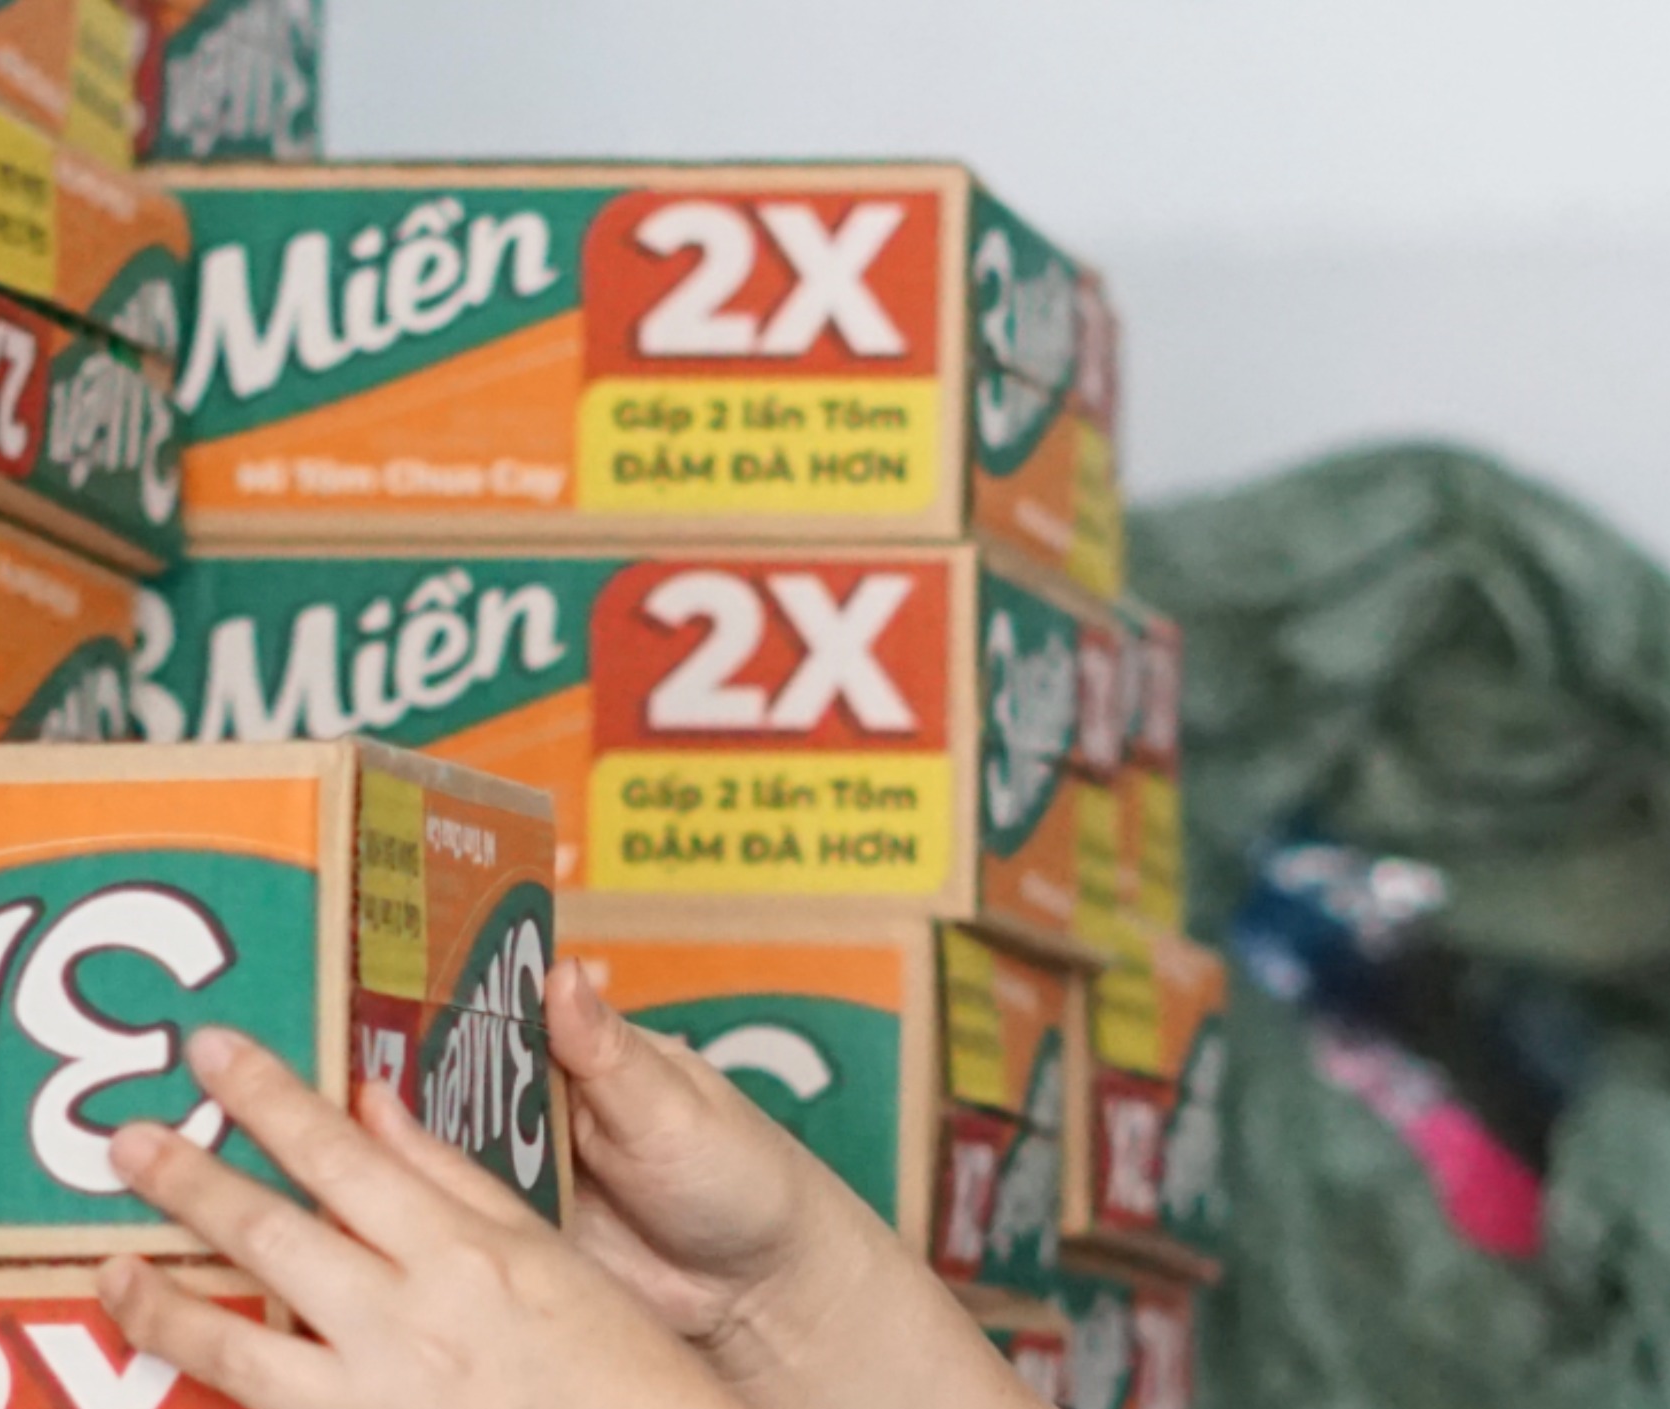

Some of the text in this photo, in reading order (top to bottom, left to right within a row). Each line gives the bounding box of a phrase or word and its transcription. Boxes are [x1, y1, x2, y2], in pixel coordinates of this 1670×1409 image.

[634, 202, 908, 357] 2X
[709, 402, 729, 430] 2
[824, 400, 909, 432] Tôm
[613, 446, 909, 494] ĐẬM ĐÀ HƠN
[643, 570, 917, 731] 2X
[718, 779, 738, 810] 2
[831, 777, 916, 811] Tôm
[622, 830, 916, 879] ĐẬM ĐÀ HƠN
